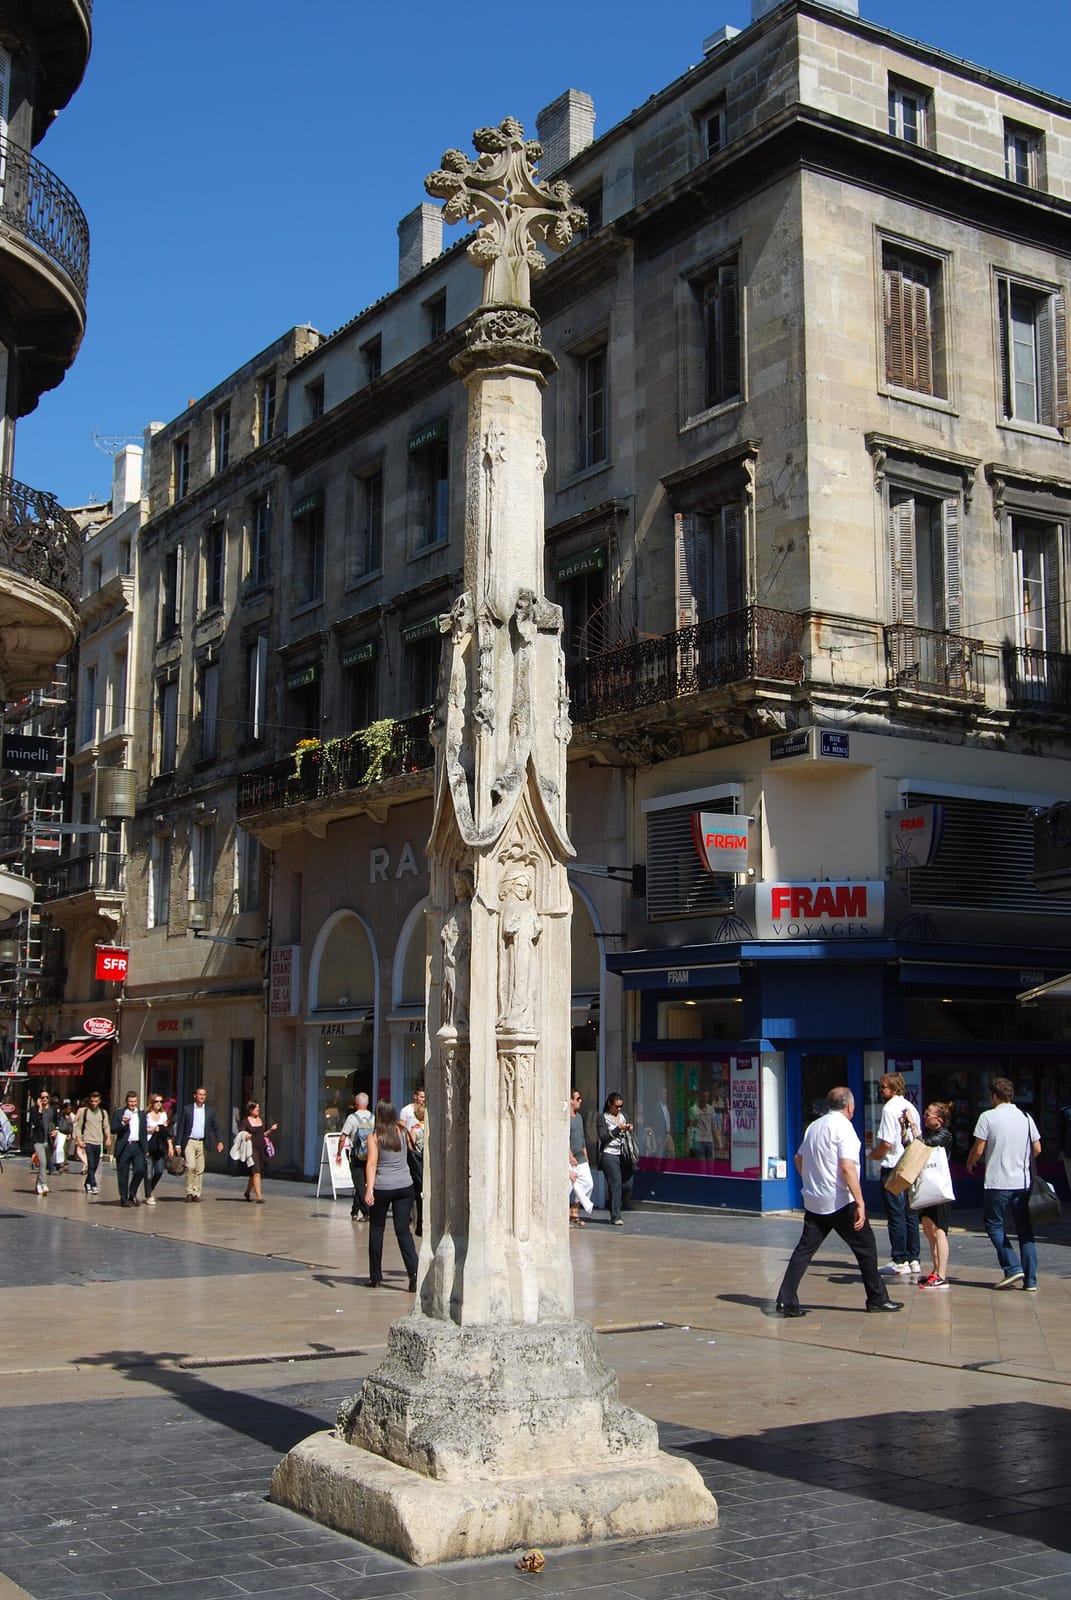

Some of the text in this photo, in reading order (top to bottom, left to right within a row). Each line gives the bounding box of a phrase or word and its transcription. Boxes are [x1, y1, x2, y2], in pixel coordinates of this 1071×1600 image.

[410, 429, 438, 448] RAFAL
[558, 560, 594, 578] RAFAL
[405, 625, 433, 640] RAFAL
[344, 651, 368, 666] RAFAL
[6, 748, 48, 760] minelli
[901, 816, 924, 832] FRAM
[706, 834, 746, 850] FRAM
[370, 842, 431, 883] RA
[772, 886, 866, 920] FRAM
[773, 922, 868, 936] VOYAGES
[272, 950, 292, 962] LE PLUS
[104, 958, 127, 970] SFR
[272, 962, 292, 975] GRAND
[273, 976, 290, 988] CHOIX
[668, 970, 689, 983] FRAM
[273, 988, 290, 1000] DE LA
[322, 1024, 346, 1036] RAFAL
[732, 1100, 756, 1110] MORAL
[733, 1118, 756, 1129] HAUT
